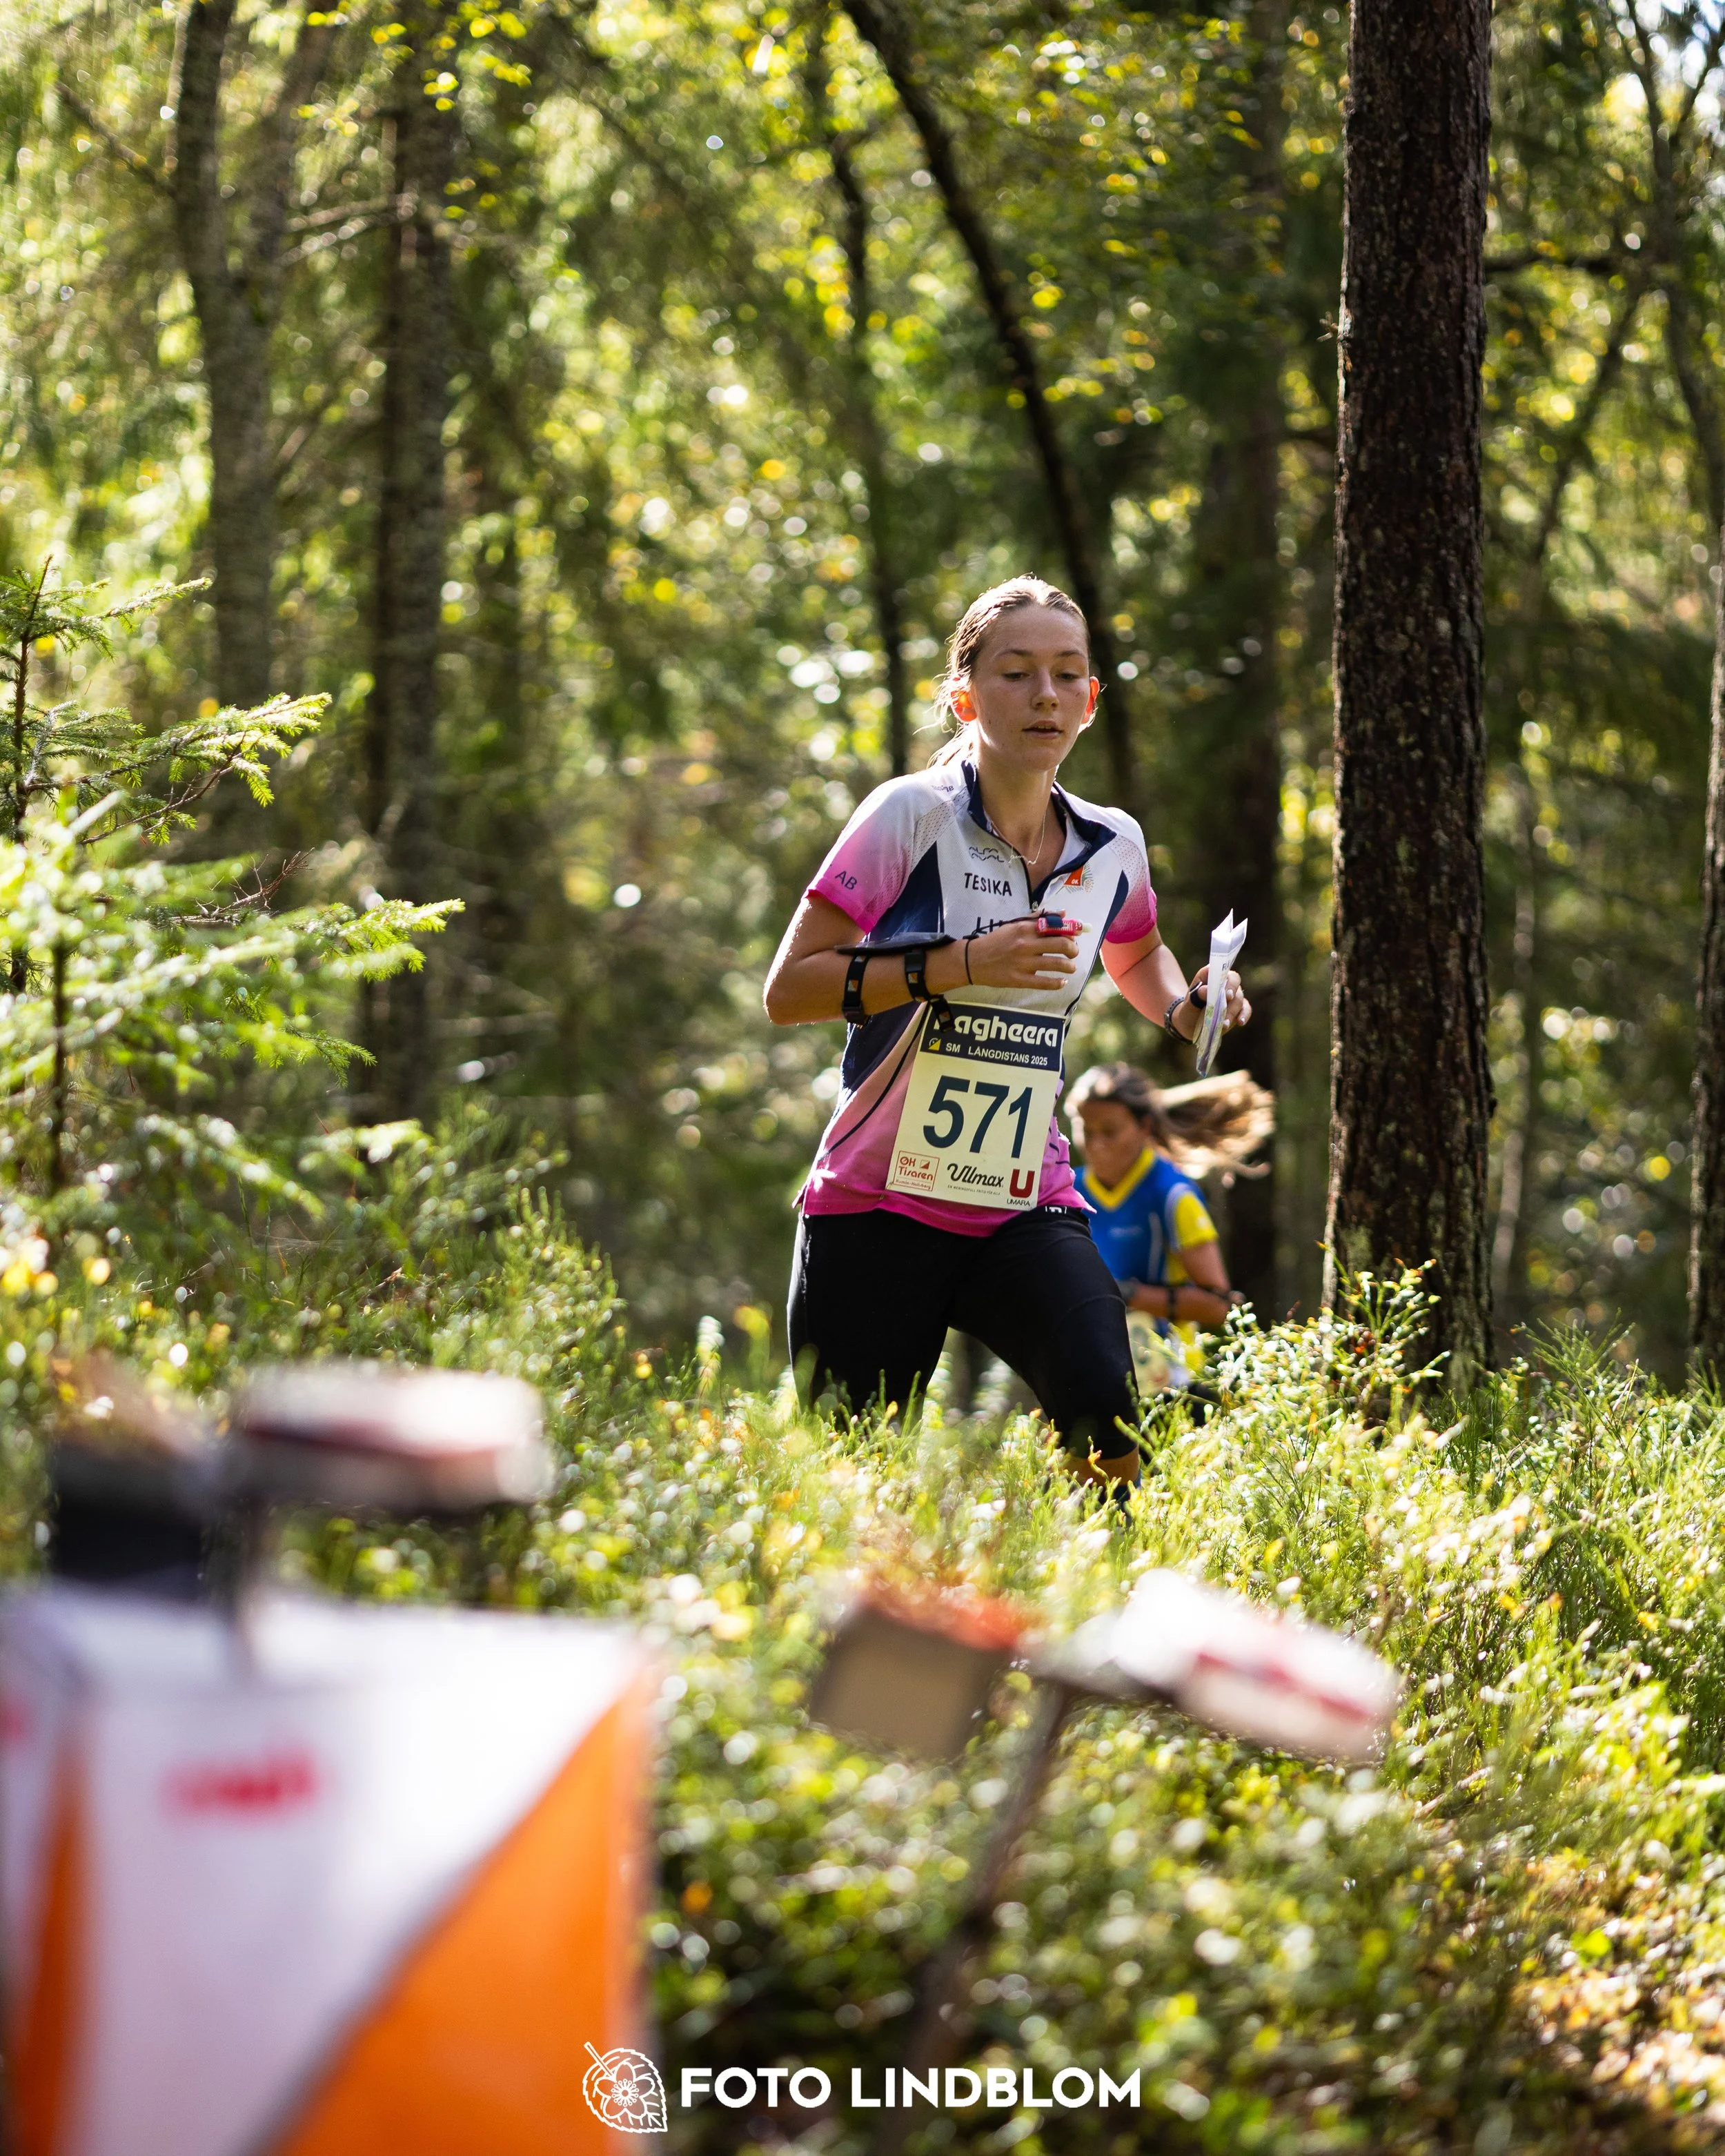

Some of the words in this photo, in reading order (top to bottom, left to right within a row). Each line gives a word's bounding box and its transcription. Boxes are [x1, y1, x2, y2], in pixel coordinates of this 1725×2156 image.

[834, 871, 858, 890] AB
[964, 873, 1012, 897] TESIKA
[934, 1016, 1058, 1047] agheera
[946, 1042, 960, 1053] SM
[968, 1046, 1029, 1063] LÅNGDISTANS
[1031, 1056, 1048, 1066] 2025
[923, 1075, 1033, 1158] 571
[898, 1166, 934, 1181] Tisaren
[947, 1163, 1004, 1187] Ullmax
[1009, 1169, 1035, 1198] U
[1007, 1198, 1031, 1207] UMARA
